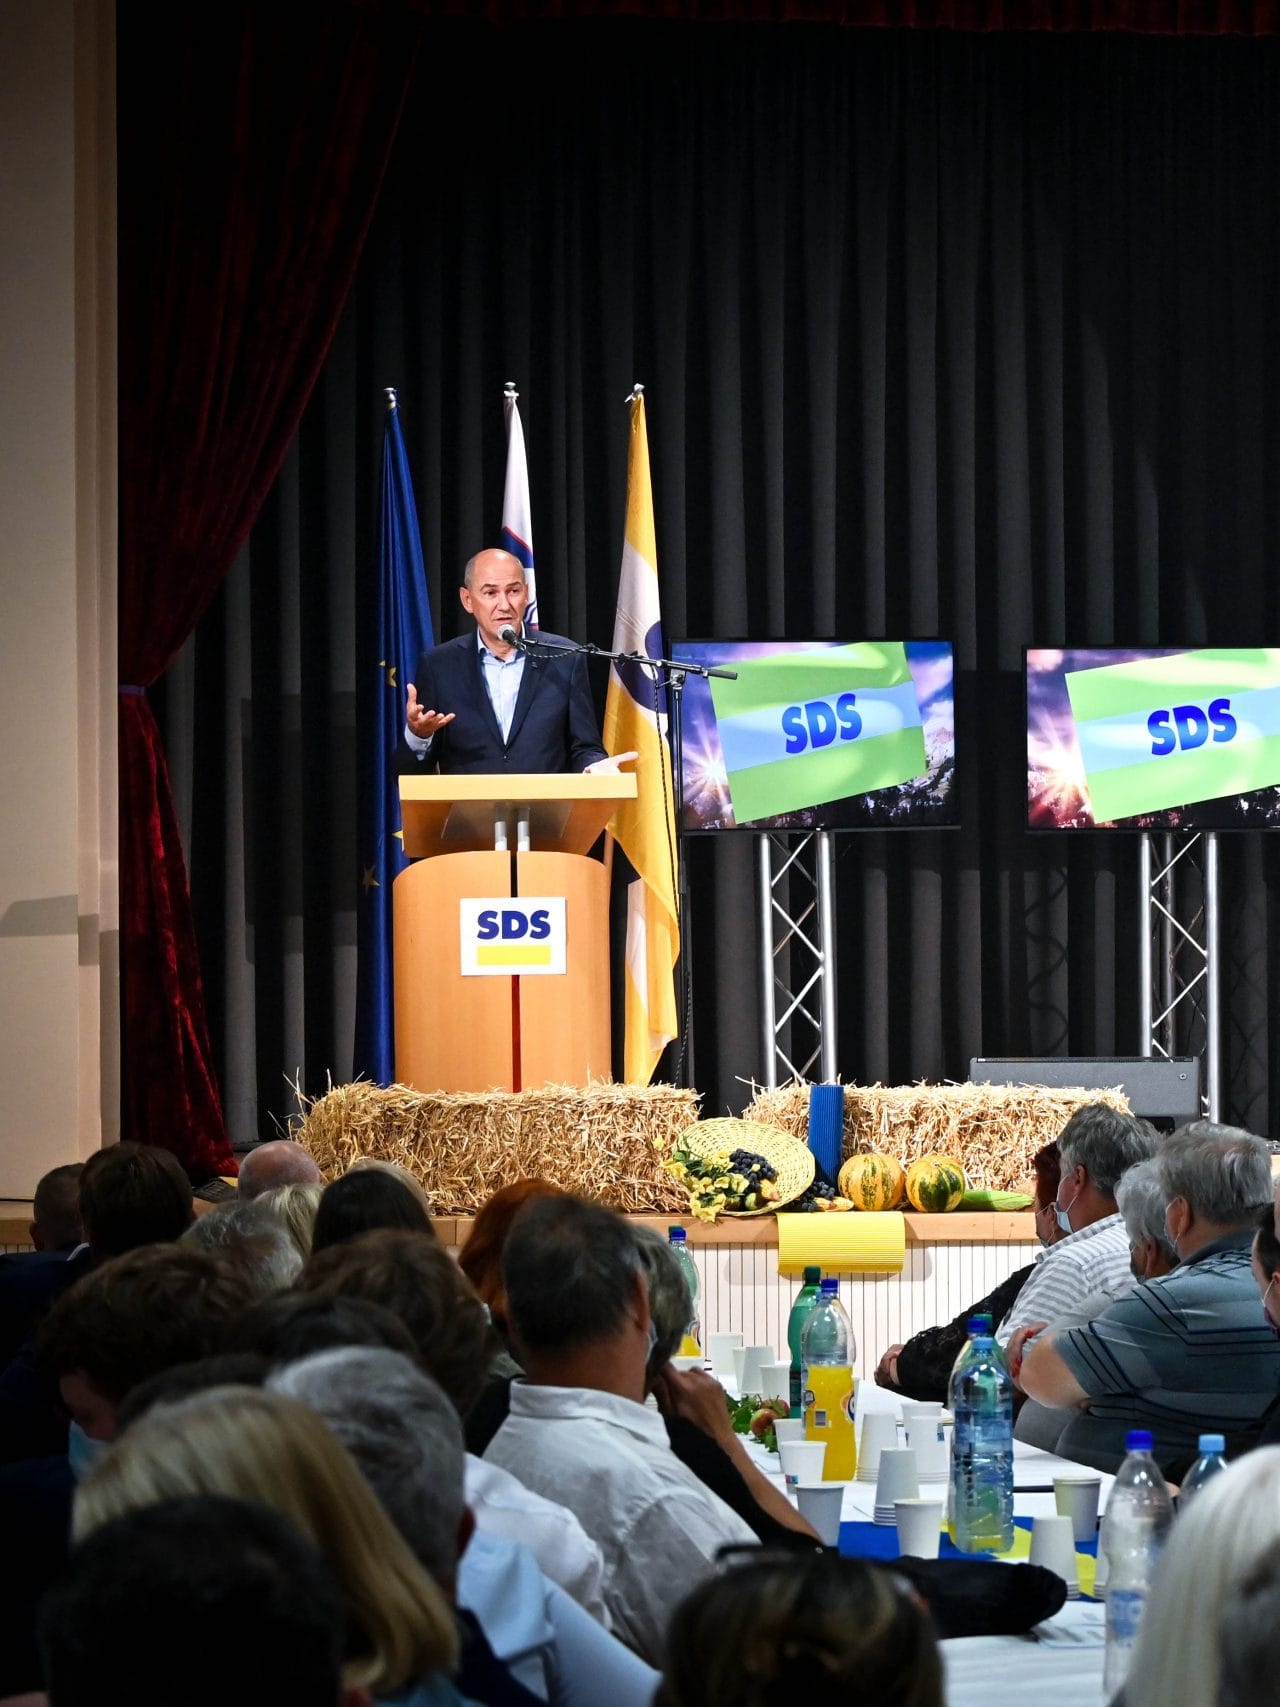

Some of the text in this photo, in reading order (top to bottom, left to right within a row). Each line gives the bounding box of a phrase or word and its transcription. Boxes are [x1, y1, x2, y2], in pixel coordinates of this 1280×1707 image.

[781, 693, 863, 754] SDS
[1147, 698, 1237, 756] SDS
[476, 909, 551, 940] SDS
